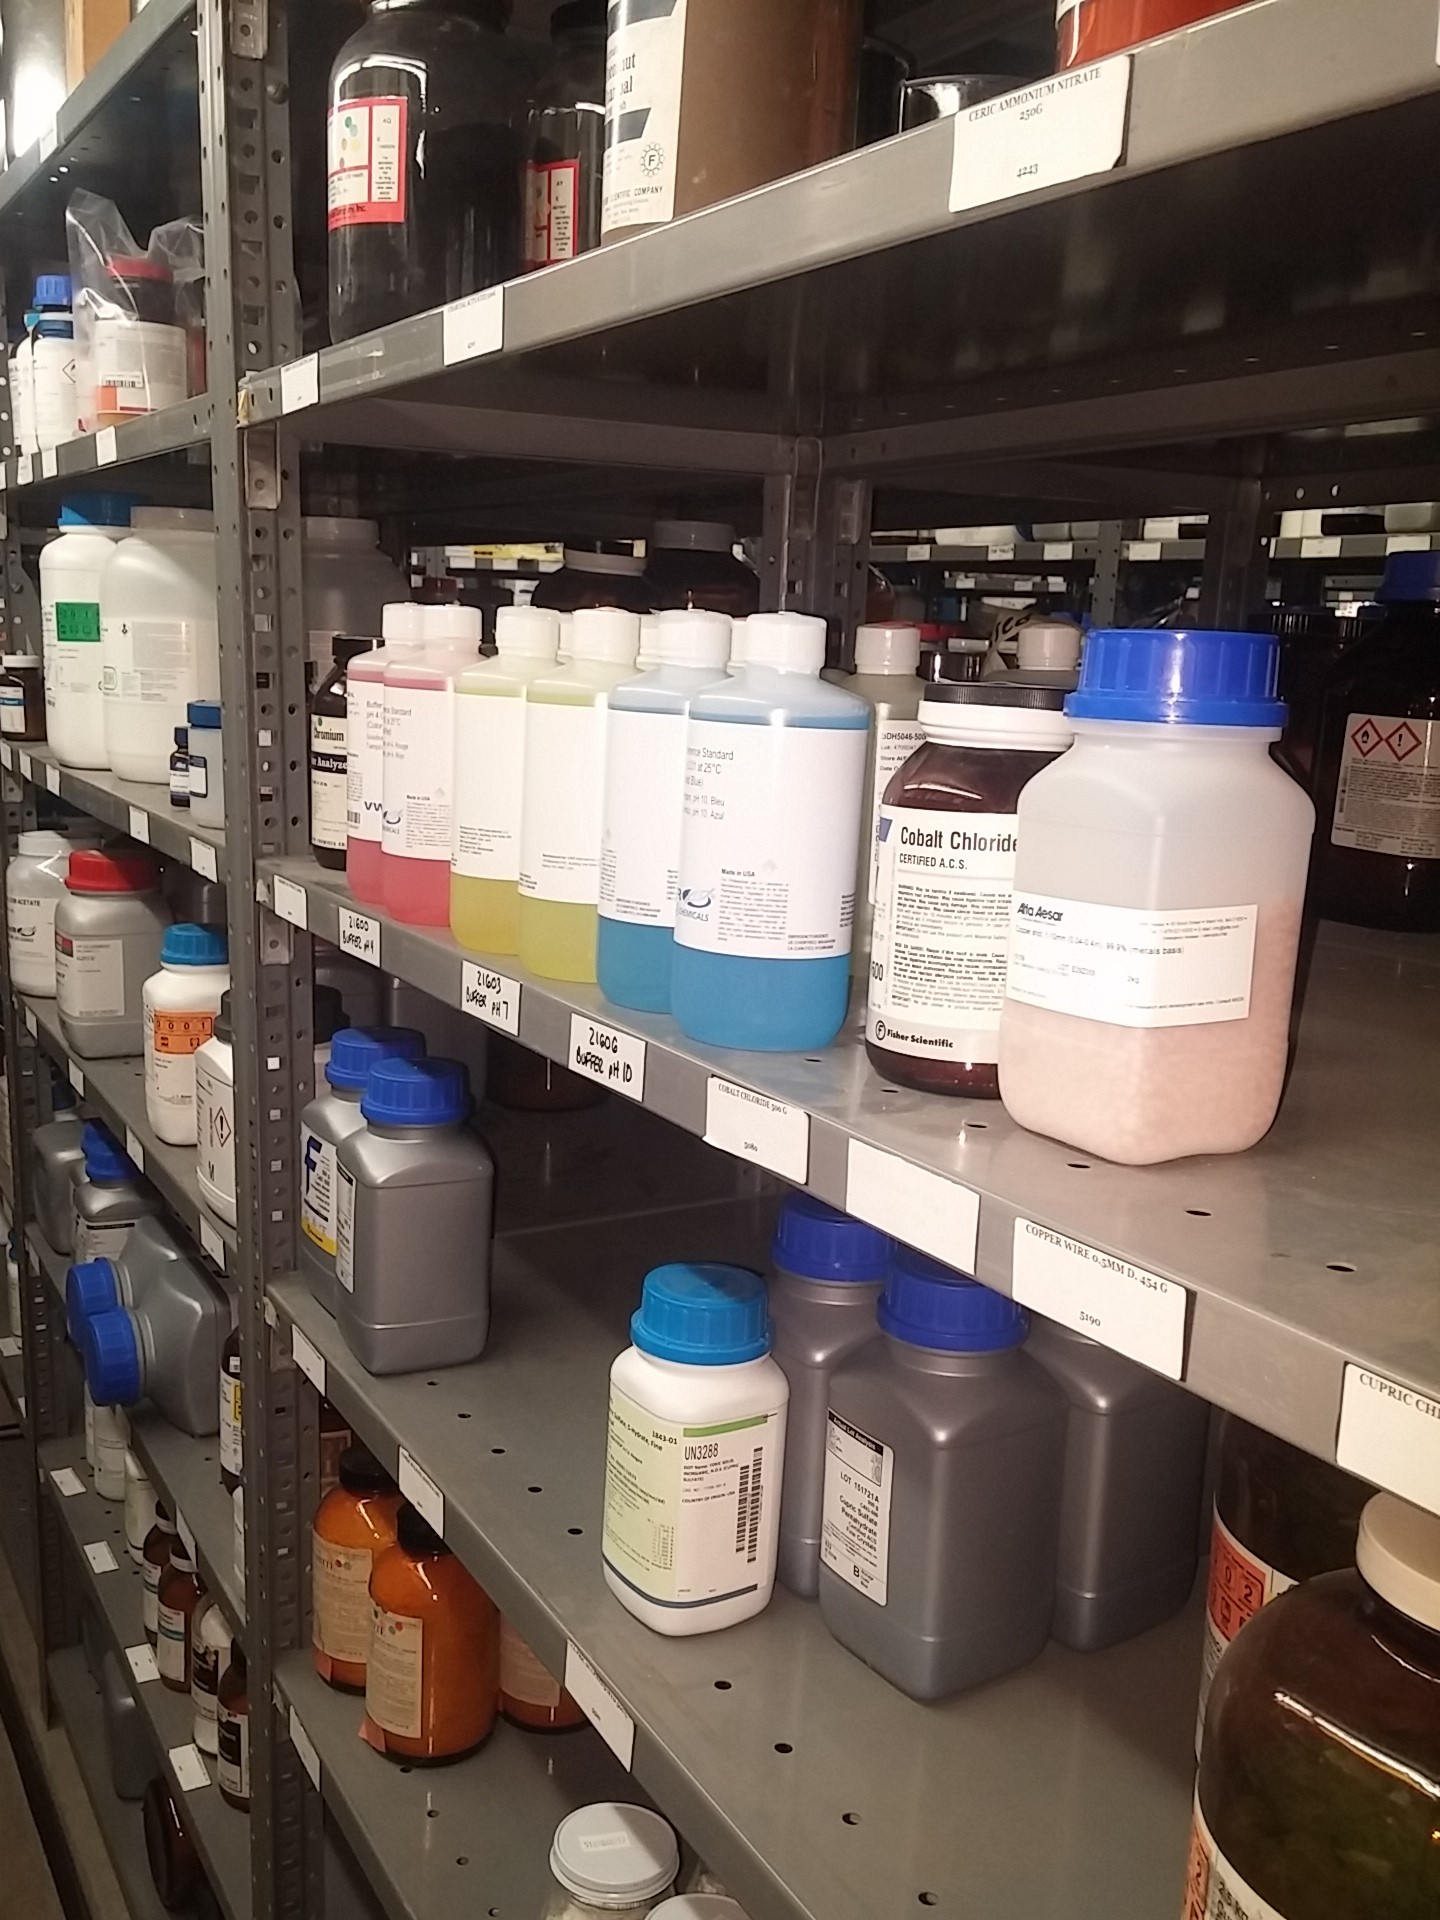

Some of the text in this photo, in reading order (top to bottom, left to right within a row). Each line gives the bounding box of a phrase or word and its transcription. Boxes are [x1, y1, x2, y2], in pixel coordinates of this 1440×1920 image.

[969, 67, 1101, 122] CERIC AMMONIUM NITRATE
[1019, 103, 1043, 121] 250G
[1016, 163, 1040, 178] 4243
[634, 186, 663, 197] COMPANY
[318, 756, 348, 771] Analyze
[702, 747, 734, 761] Standard
[900, 826, 943, 850] Cobalt
[899, 853, 968, 870] CERTIFIED A.C.S.
[18, 898, 41, 907] ACETATE
[1017, 902, 1064, 921] Alfa Aesar
[348, 915, 369, 932] 21600
[477, 970, 502, 994] 21603
[466, 986, 487, 1008] BUFFER
[502, 1001, 509, 1020] 7
[588, 1027, 618, 1054] 21606
[887, 1029, 909, 1041] Fisher
[910, 1034, 954, 1049] Scientific
[576, 1046, 604, 1075] BUFFER
[623, 1062, 633, 1083] 10
[718, 1083, 740, 1100] COBALT
[740, 1092, 770, 1109] CHLORIDE
[1025, 1224, 1168, 1293] COPPER WIRE 0.5MM D. 454 G
[1079, 1311, 1101, 1327] 5190
[1359, 1373, 1413, 1406] CUPRIC
[652, 1430, 678, 1445] 1843-01
[684, 1443, 719, 1460] UN3288
[840, 1471, 852, 1484] LOT
[839, 1494, 878, 1527] Cupric Sulfate
[841, 1506, 877, 1537] Pentahydrate
[853, 1564, 859, 1578] B
[1243, 1584, 1252, 1604] 2
